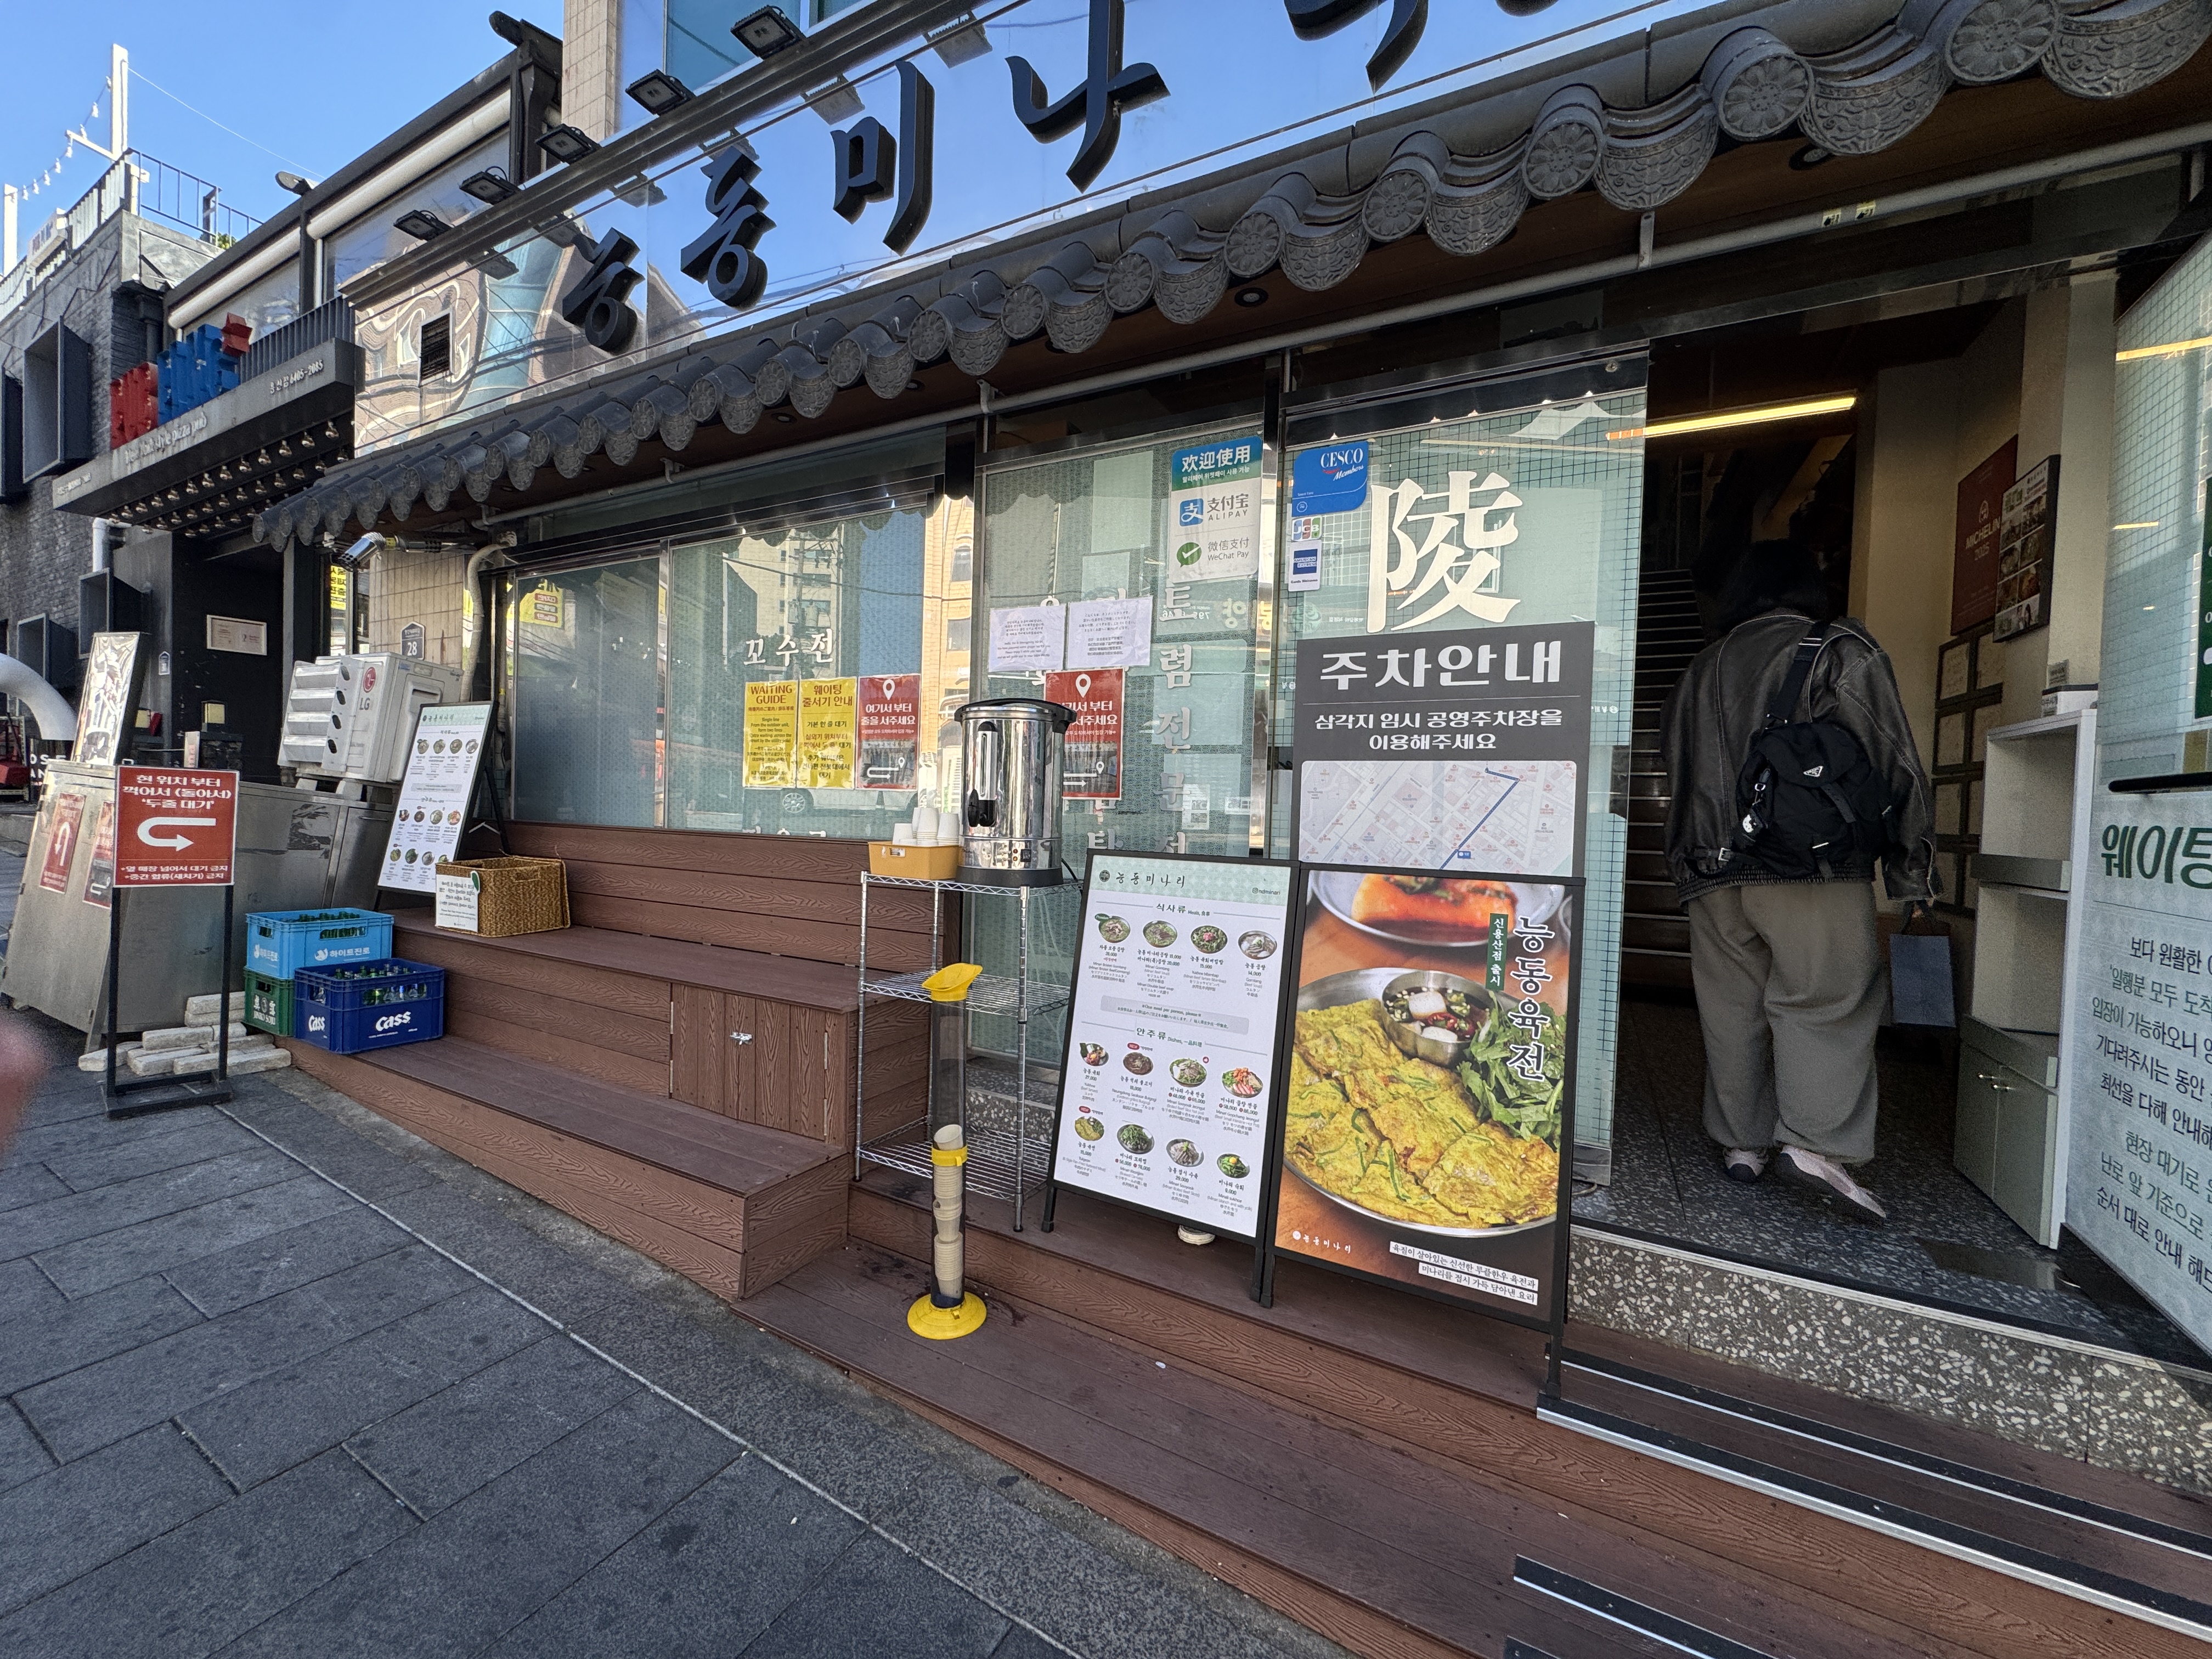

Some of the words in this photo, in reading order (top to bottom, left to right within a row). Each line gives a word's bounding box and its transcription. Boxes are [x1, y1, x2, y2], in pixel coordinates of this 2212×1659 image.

[561, 0, 1432, 354] 능동미나
[1182, 445, 1251, 472] 欢迎使用
[1321, 448, 1363, 469] CESCO
[1333, 464, 1364, 481] Members
[1207, 494, 1249, 514] 支付宝
[1209, 509, 1248, 521] ALIPAY
[1293, 524, 1319, 535] JCB
[1965, 516, 2001, 549] MICHELIN
[1207, 537, 1250, 552] 微信支付
[1367, 470, 1523, 633] 陵
[1207, 552, 1234, 561] WeChat
[1237, 550, 1249, 559] Pay
[407, 641, 417, 656] 28
[1320, 640, 1561, 690] 주차안내
[751, 685, 792, 695] WAITING
[814, 685, 842, 695] 웨이팅
[359, 697, 370, 711] LG
[756, 695, 787, 704] GUIDE
[802, 697, 831, 707] 줄서기
[833, 696, 853, 706] 안내
[865, 703, 892, 713] 여기서
[894, 703, 912, 713] 부터
[1090, 701, 1113, 712] 부터
[861, 716, 879, 726] 줄을
[879, 715, 916, 725] 서주세요
[1071, 714, 1118, 726] 서주세요
[1315, 714, 1374, 730] 삼각지
[1380, 713, 1420, 729] 임시
[1427, 709, 1563, 728] 공영주차장을
[1369, 734, 1497, 751] 이용해주세요
[137, 775, 153, 785] 현
[156, 776, 188, 786] 위치
[191, 777, 221, 787] 부터
[175, 788, 232, 799] (돌아서)
[1116, 872, 1185, 888] 능동미나리
[1156, 903, 1186, 913] 식사류
[1492, 918, 1504, 962] 신용산점
[329, 947, 370, 958] 하이트진로
[2129, 936, 2154, 962] 보다
[2159, 943, 2202, 975] 원활한
[1490, 964, 1502, 988] 출시
[1507, 916, 1555, 1082] 능동육전
[2149, 980, 2179, 1008] 모두
[308, 1015, 325, 1032] Cass
[375, 1011, 411, 1032] Cass
[2092, 997, 2124, 1028] 입장이
[2126, 1012, 2197, 1058] 가능하오니
[1136, 1027, 1166, 1040] 안주류
[2096, 1034, 2169, 1085] 기다려주시는
[2175, 1068, 2205, 1103] 동안
[2101, 1073, 2134, 1107] 최선을
[2138, 1092, 2168, 1125] 다해
[2125, 1130, 2153, 1164] 현장
[2157, 1149, 2199, 1194] 대기로
[2101, 1151, 2124, 1185] 난로
[2129, 1171, 2143, 1199] 앞
[2147, 1182, 2204, 1241] 기준으로
[2096, 1186, 2120, 1221] 순서
[2124, 1206, 2149, 1243] 대로
[2155, 1228, 2182, 1269] 안내
[1303, 1234, 1351, 1254] 능동미나리
[1417, 1251, 1448, 1265] 살아있는
[1450, 1259, 1473, 1272] 신선한
[1510, 1274, 1536, 1289] 육전과
[1422, 1265, 1453, 1280] 미나리를
[1454, 1274, 1470, 1285] 접시
[1472, 1278, 1488, 1289] 가득
[1491, 1283, 1516, 1297] 담아낸
[1517, 1291, 1535, 1302] 요리
